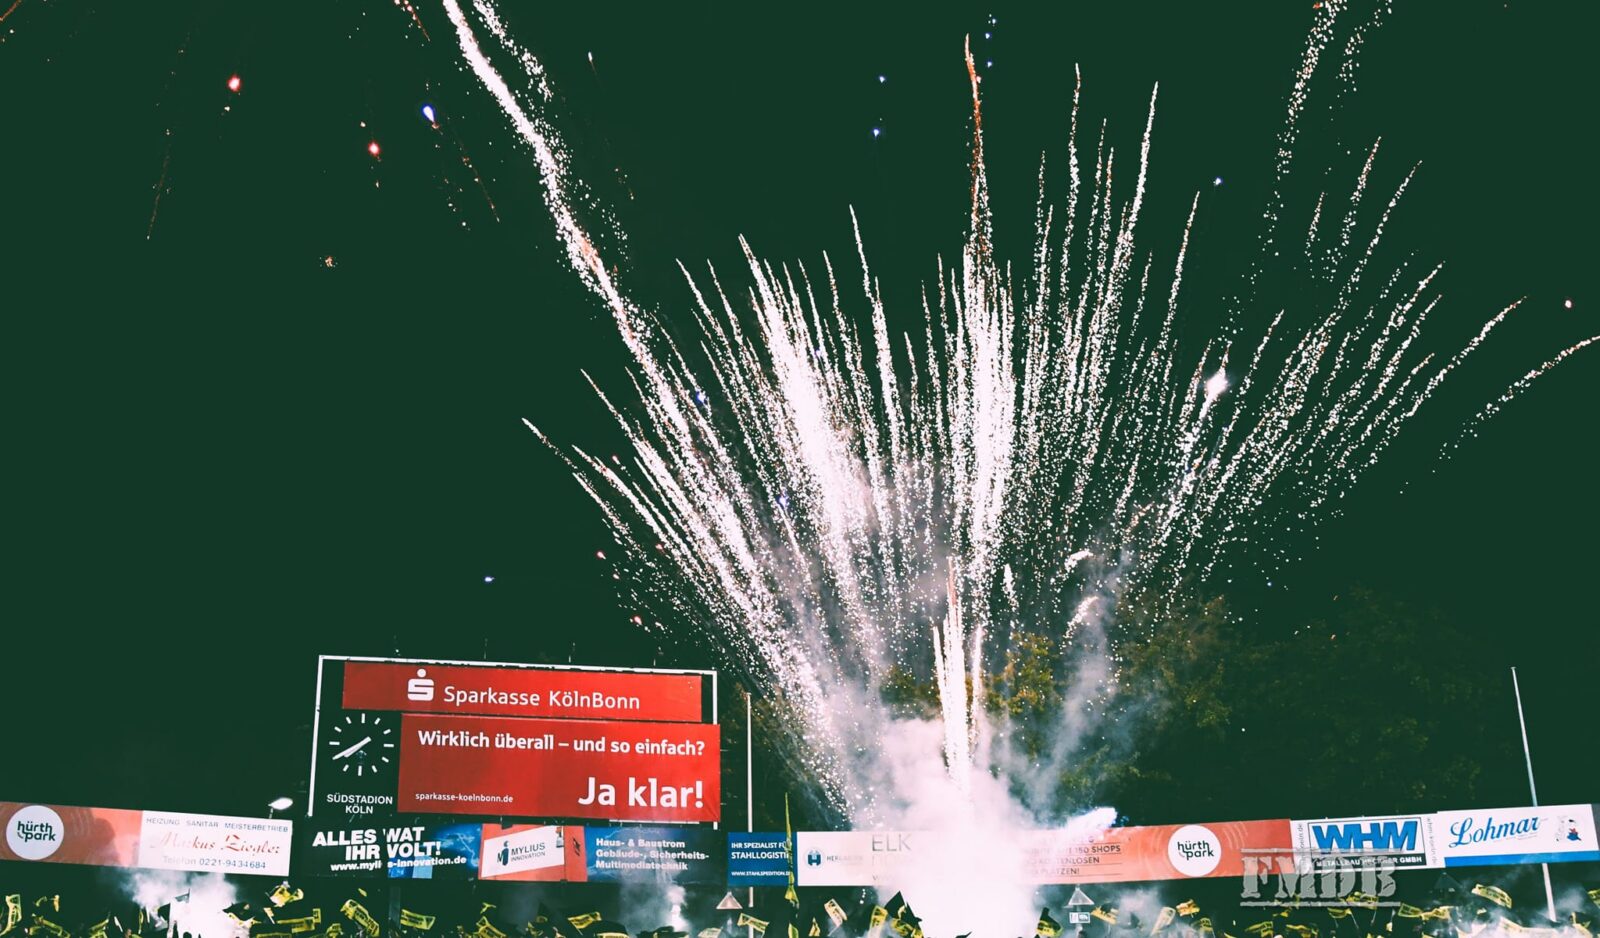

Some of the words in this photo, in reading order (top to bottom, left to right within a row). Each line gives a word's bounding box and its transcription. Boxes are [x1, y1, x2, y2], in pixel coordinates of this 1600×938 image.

[443, 685, 541, 707] Sparkasse
[549, 690, 640, 710] KölnBonn
[418, 730, 490, 748] Wirklich
[495, 733, 554, 750] überall
[573, 737, 605, 753] und
[610, 740, 630, 754] so
[635, 738, 705, 756] einfach?
[415, 792, 514, 803] sparkasse-koelnbonn.de
[578, 777, 616, 806] Ja
[628, 777, 704, 808] klar!
[326, 793, 393, 805] SÜDSTADION
[345, 804, 374, 814] KÖLN
[17, 821, 53, 833] hürth
[146, 817, 181, 826] HEIZUNG
[224, 822, 289, 833] MEISTERBETRIEB
[24, 831, 56, 843] park
[312, 829, 377, 847] ALLES
[1312, 821, 1418, 854] WHM
[1449, 816, 1540, 848] Lohmar
[511, 842, 546, 856] MYLIUS
[596, 838, 625, 847] Haus-
[627, 838, 634, 847] &
[638, 839, 686, 848] Baustrom
[1177, 840, 1210, 850] hürth
[345, 845, 381, 861] IHR
[387, 841, 442, 859] VOLT!
[649, 850, 710, 861] Sicherheits-
[1091, 845, 1121, 854] SHOPS
[1185, 849, 1215, 860] park
[511, 851, 546, 862] INNOVATION
[1400, 855, 1423, 864] GMBH
[199, 858, 267, 869] 0221-9434684
[330, 856, 467, 872] www.mylis-innovation.de
[596, 861, 688, 871] Multimediatechnik
